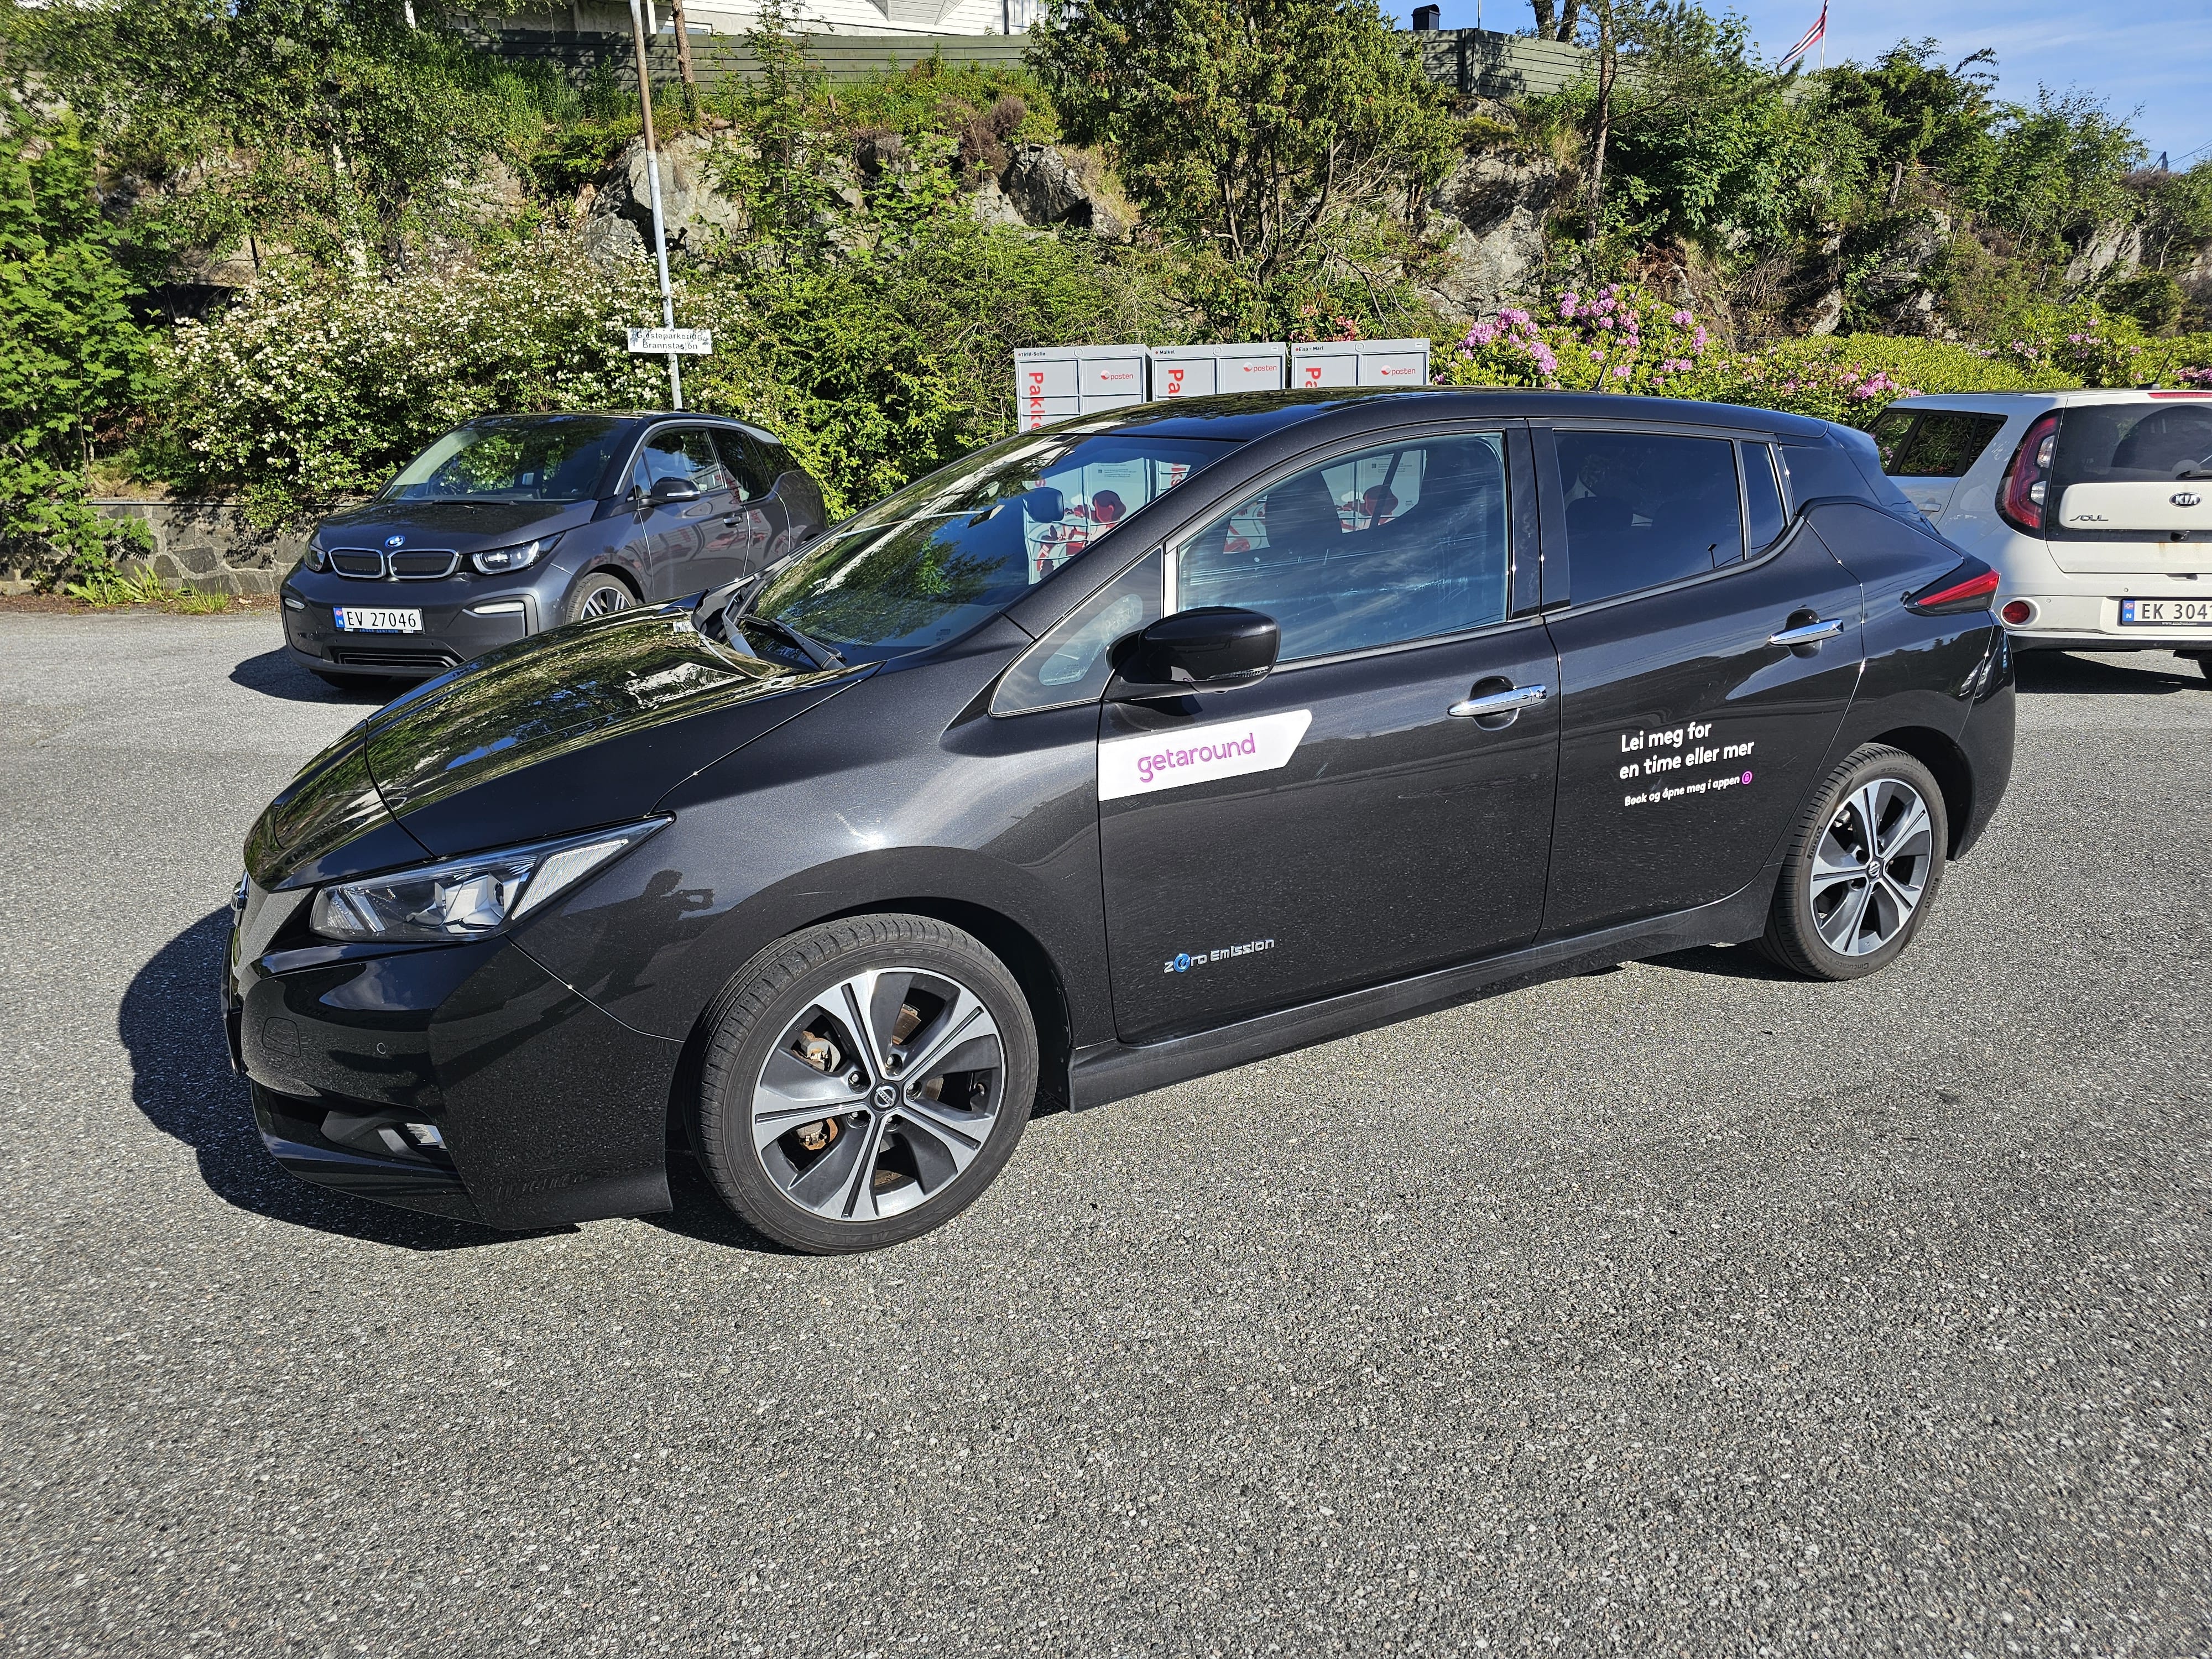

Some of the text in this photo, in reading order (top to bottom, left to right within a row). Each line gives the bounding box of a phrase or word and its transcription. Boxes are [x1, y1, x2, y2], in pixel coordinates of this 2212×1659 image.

[643, 341, 698, 350] Brannstasjon
[1110, 373, 1134, 381] posten
[2175, 495, 2198, 504] KIA
[347, 611, 416, 627] EV 27046
[2142, 603, 2163, 619] EK
[1621, 721, 1712, 752] Lei meg for
[1137, 733, 1256, 782] getaround
[1619, 741, 1755, 779] en time eller mer
[1624, 775, 1740, 807] Book og åpne meg i appen
